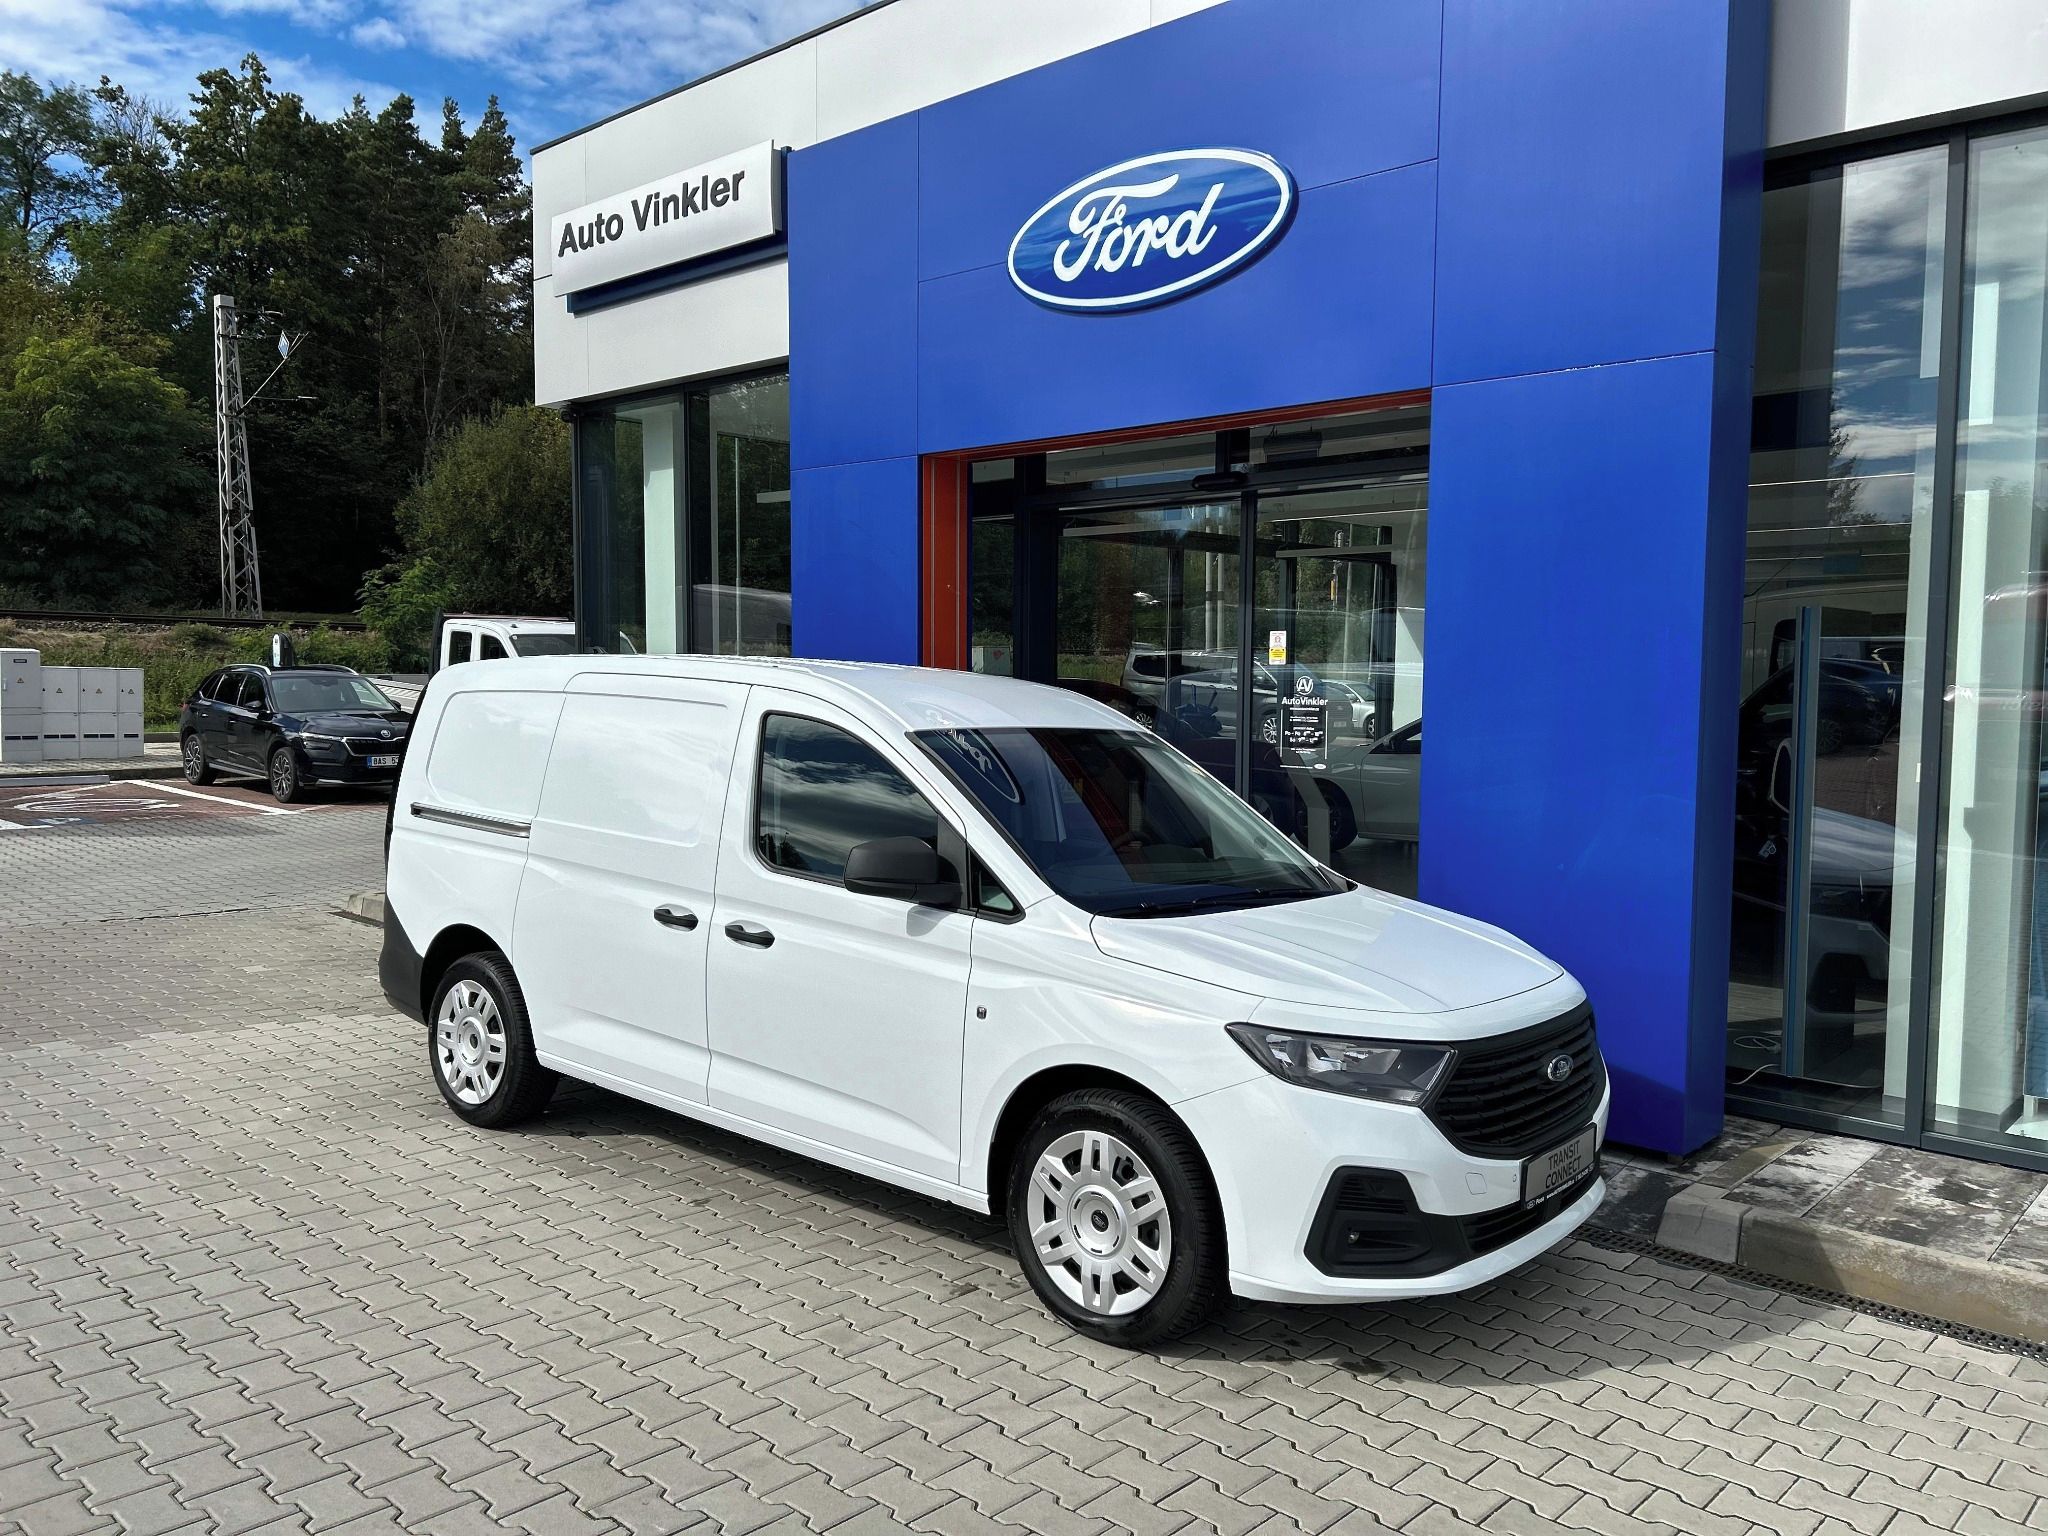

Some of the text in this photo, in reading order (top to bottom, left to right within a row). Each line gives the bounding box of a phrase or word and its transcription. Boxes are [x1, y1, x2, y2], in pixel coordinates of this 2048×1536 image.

[558, 170, 745, 258] Auto Vinkler
[1052, 173, 1225, 283] Ford
[1281, 696, 1329, 706] AutoVinkler
[1545, 1155, 1582, 1189] CONNECT
[1548, 1139, 1581, 1171] TRANSIT
